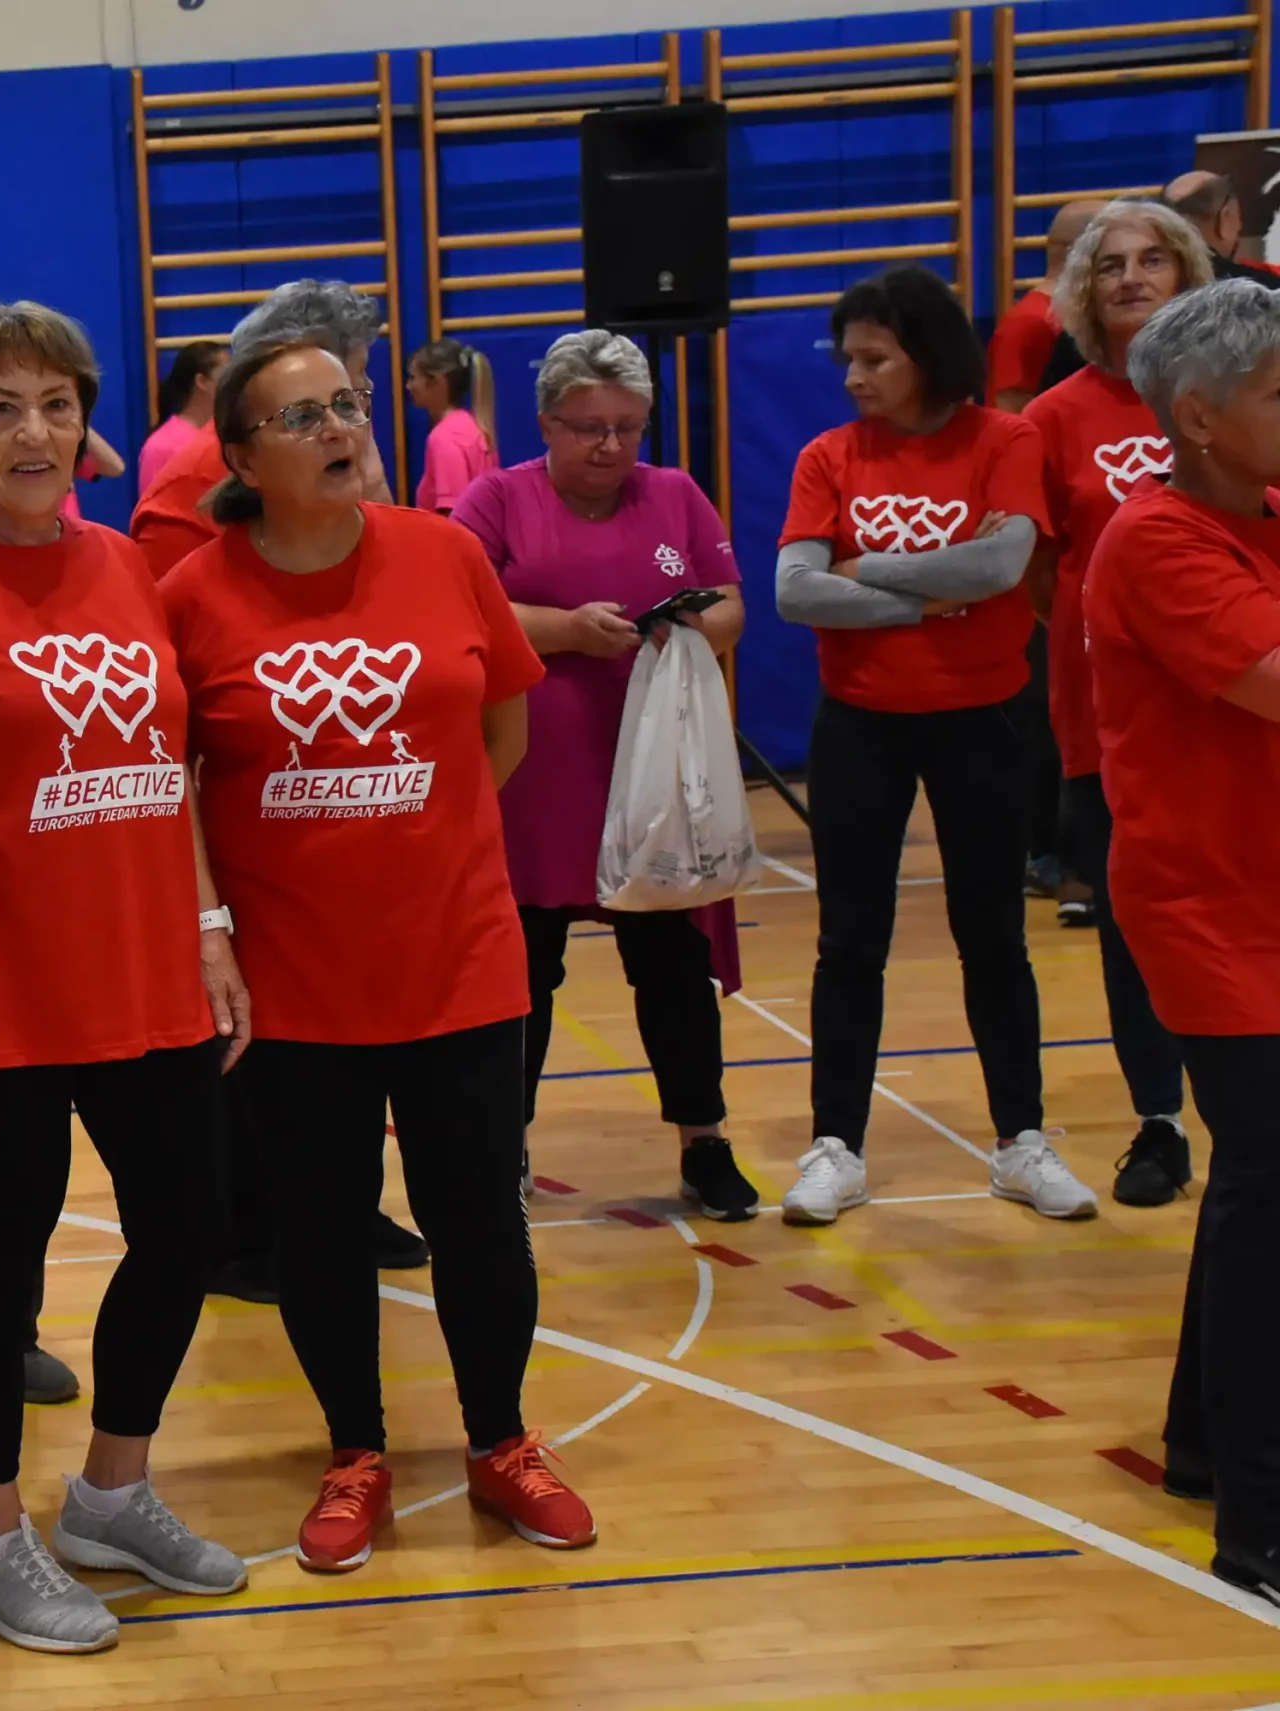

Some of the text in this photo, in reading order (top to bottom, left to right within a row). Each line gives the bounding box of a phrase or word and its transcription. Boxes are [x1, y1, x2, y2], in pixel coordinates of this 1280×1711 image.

[42, 771, 182, 811] #BEACTIVE
[269, 769, 428, 802] #BEACTIVE
[28, 804, 179, 834] EUROPSKI TJEDAN SPORTA
[260, 801, 424, 820] EUROPSKI TJEDAN SPORTA
